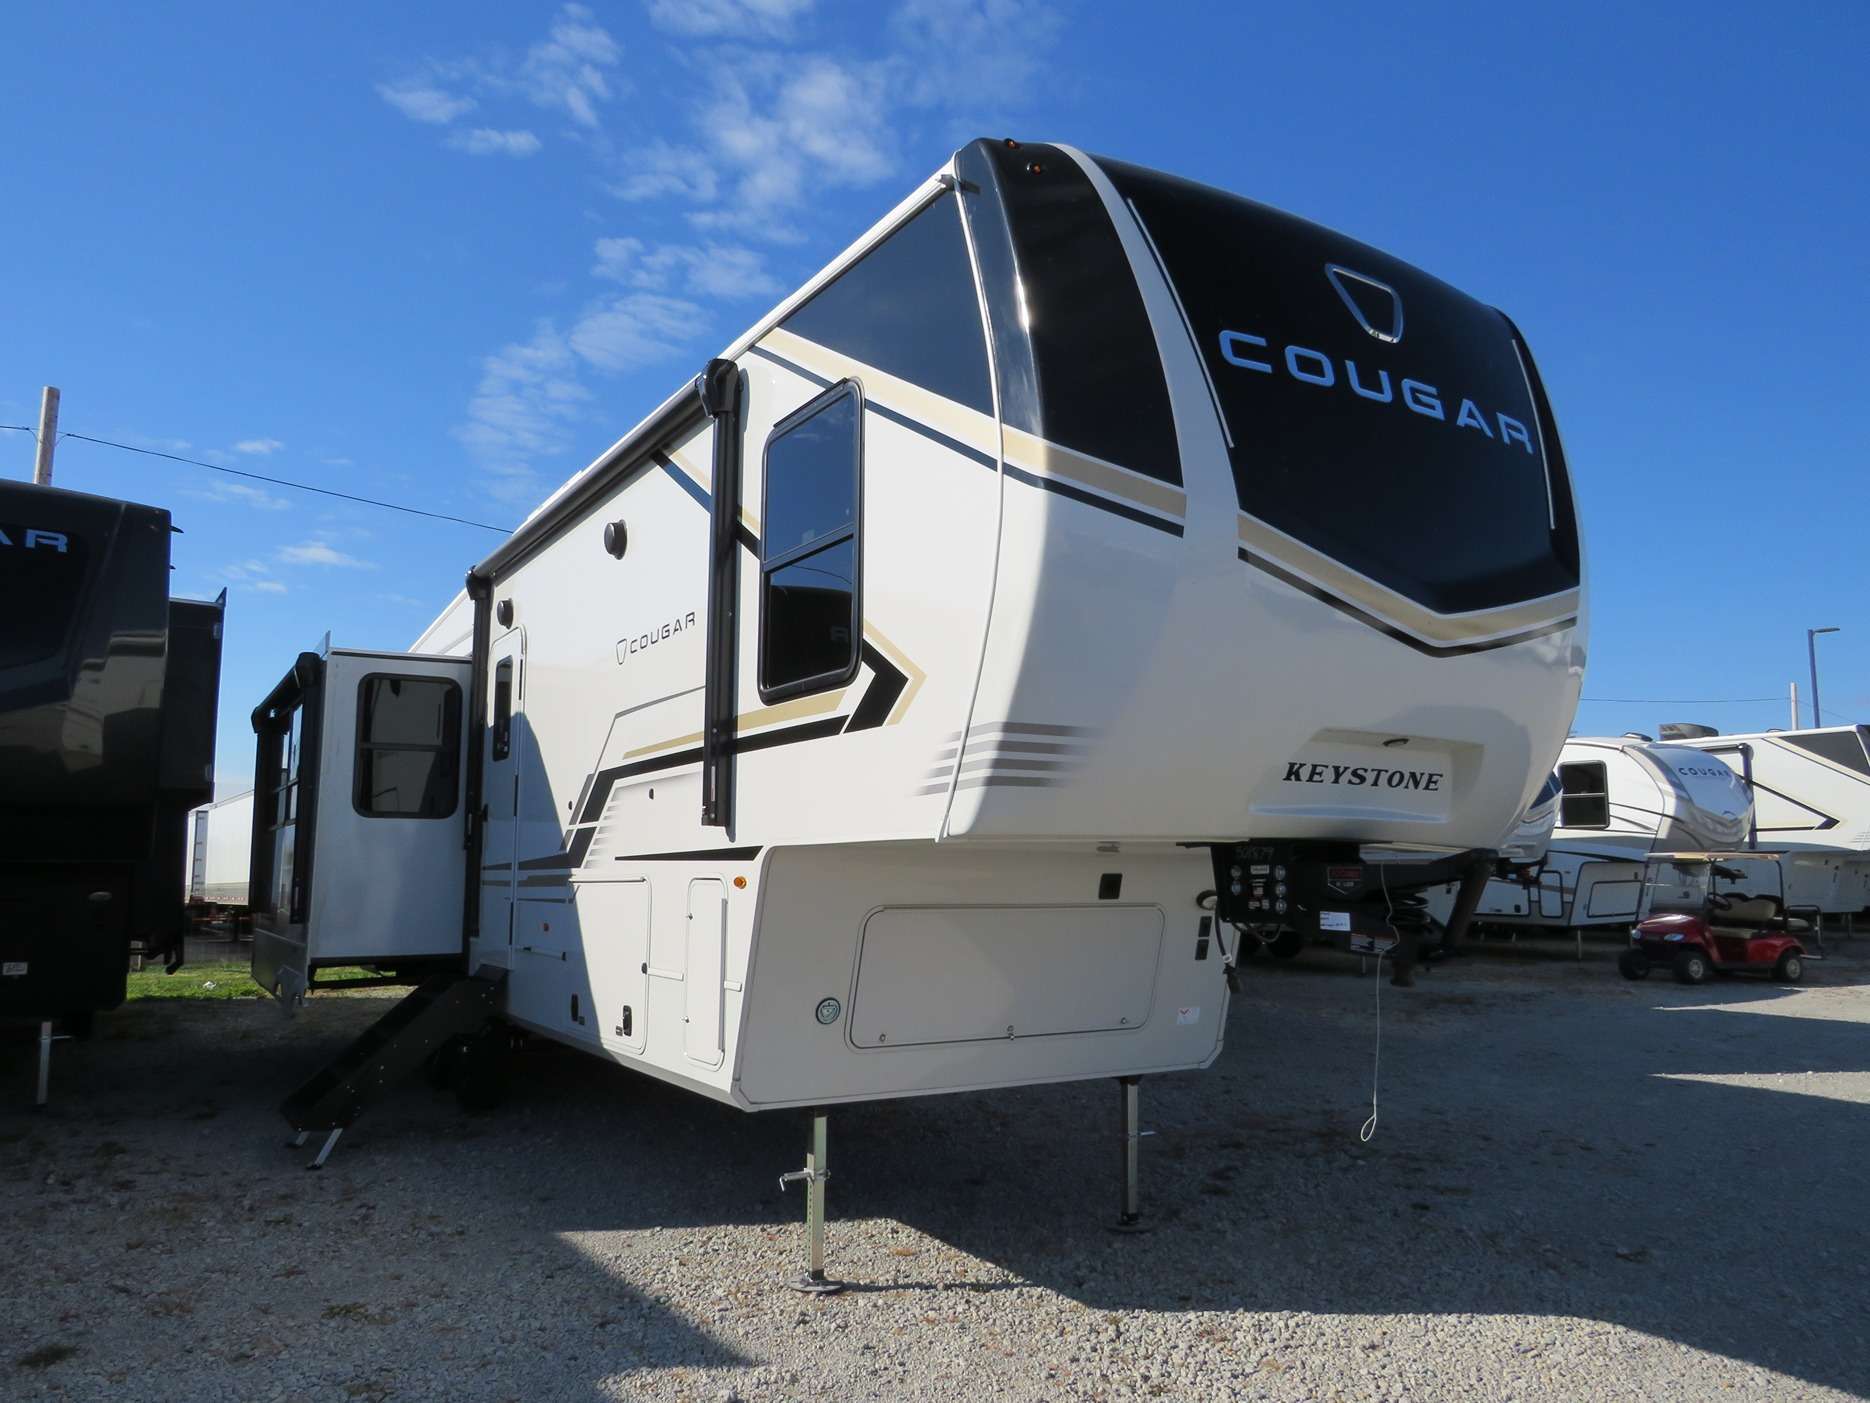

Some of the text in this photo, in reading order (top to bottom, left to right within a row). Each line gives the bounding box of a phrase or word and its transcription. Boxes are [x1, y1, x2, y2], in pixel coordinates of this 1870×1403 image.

[1218, 329, 1534, 454] COUGAR
[629, 611, 696, 655] COUGAR
[1282, 761, 1444, 792] KEYSTONE
[1678, 767, 1730, 777] COUGAR
